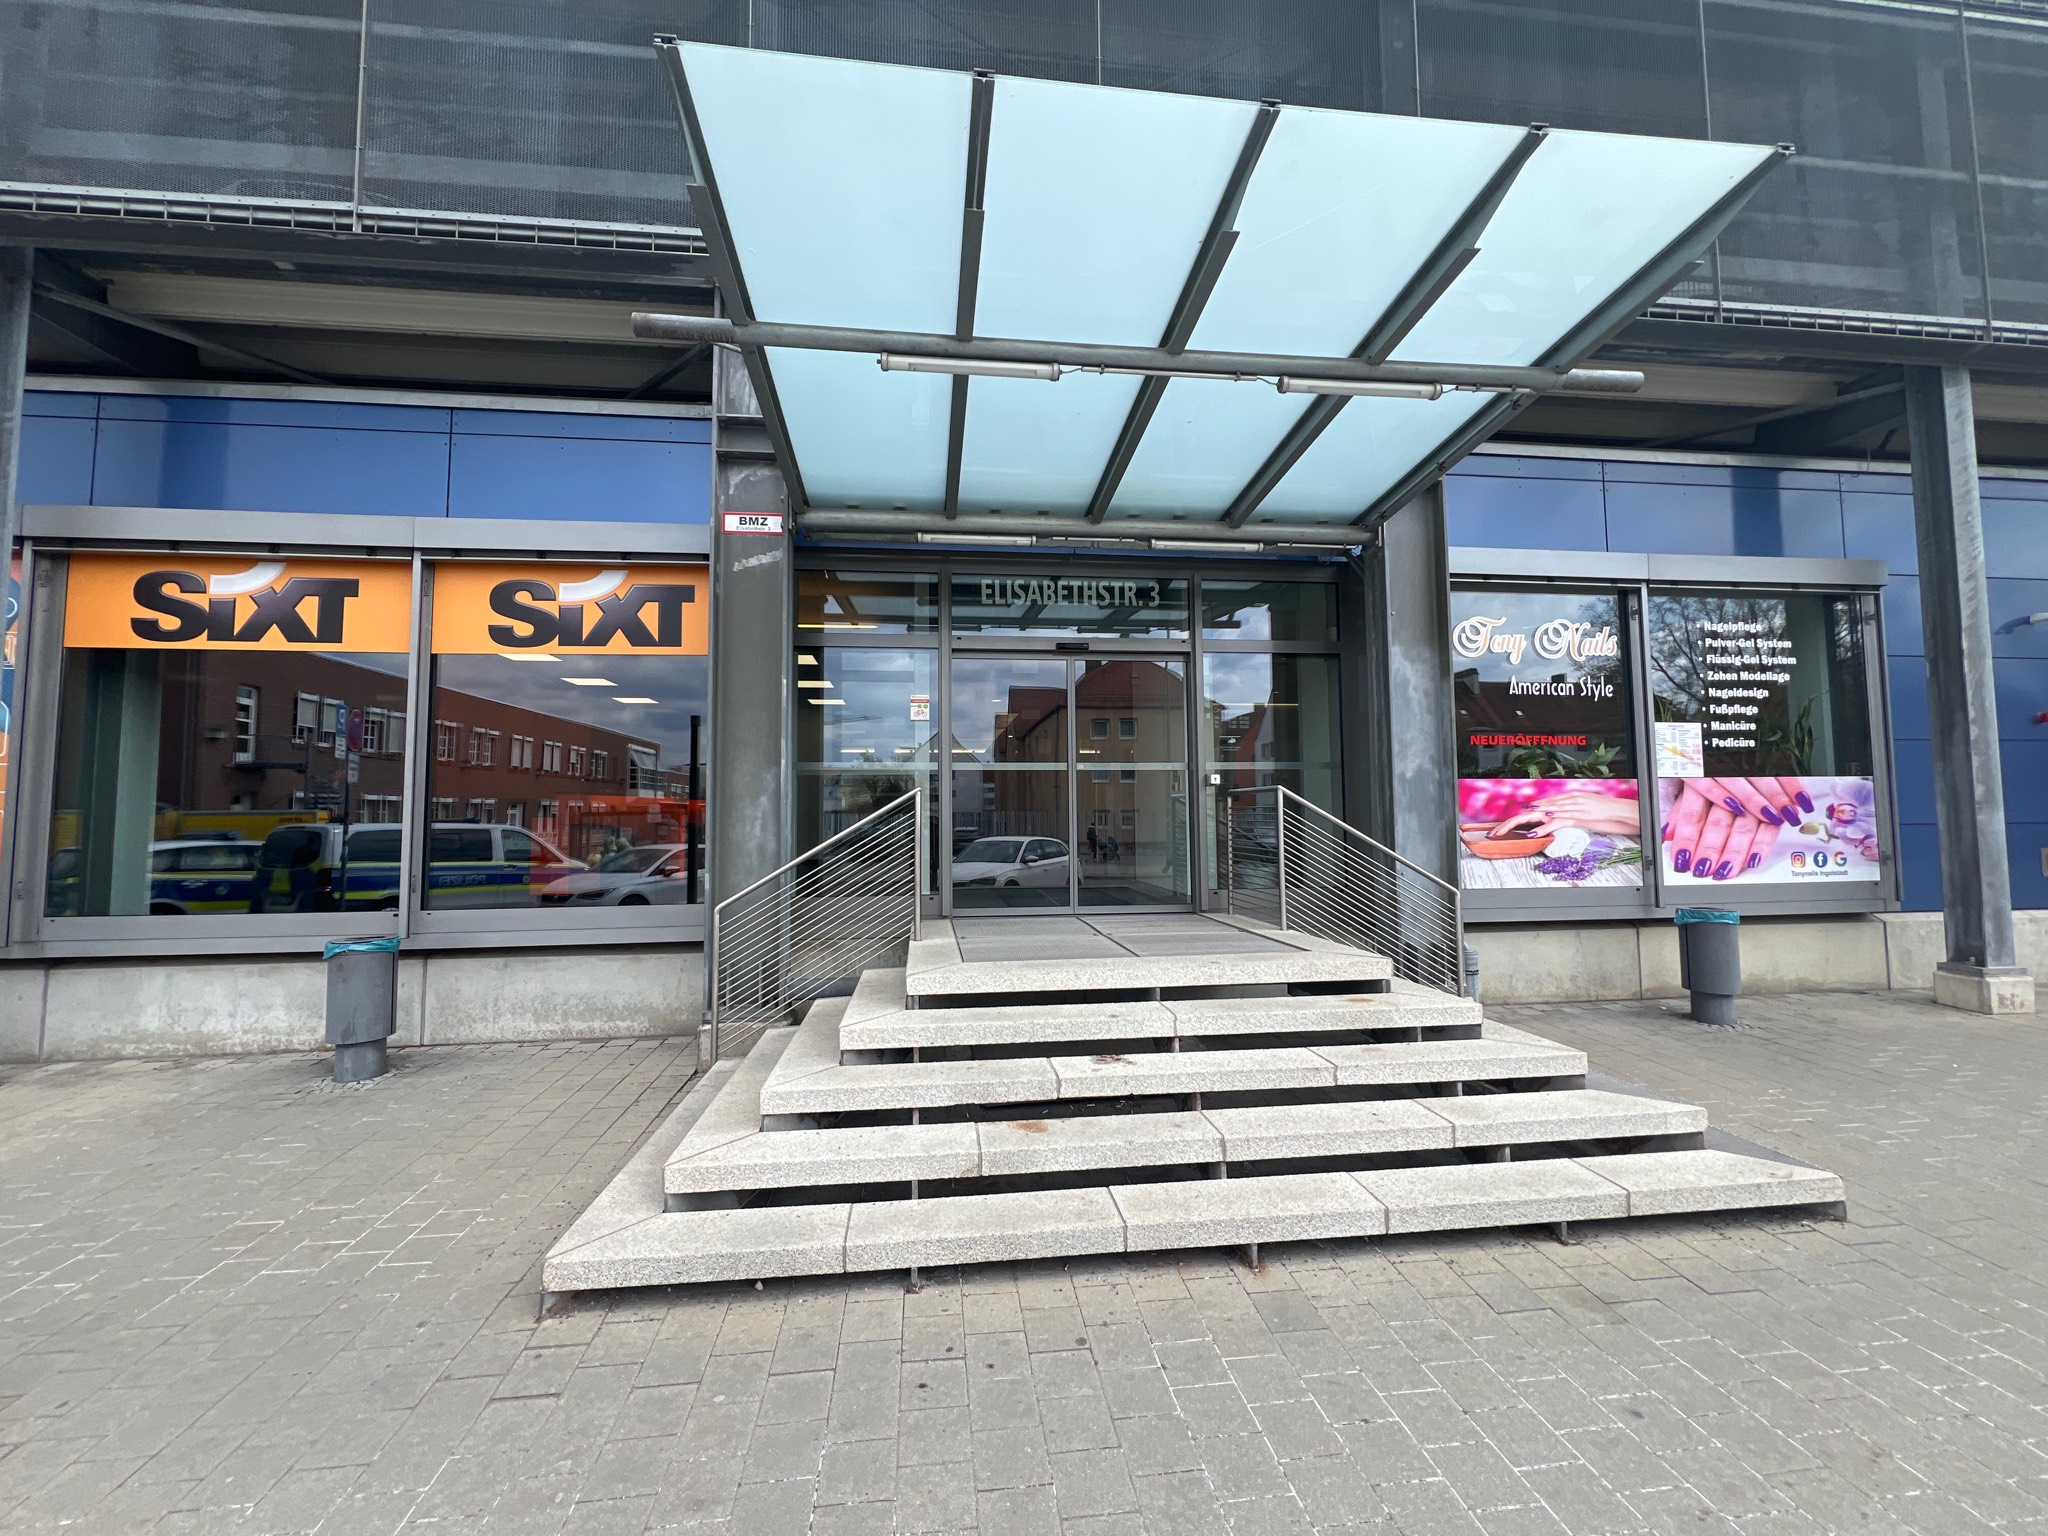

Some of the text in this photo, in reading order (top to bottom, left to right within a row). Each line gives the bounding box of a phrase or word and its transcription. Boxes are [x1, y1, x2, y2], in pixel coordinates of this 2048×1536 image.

[739, 516, 768, 526] BMZ
[981, 578, 1160, 608] ELISABETHSTR. 3
[1703, 621, 1762, 633] Nagelpflege
[1532, 618, 1618, 662] Nails
[1705, 638, 1792, 650] Pulver-Gel System
[1706, 653, 1797, 666] Flüssig-Gel System
[1707, 670, 1791, 683] Zehen Modellage
[1509, 674, 1614, 702] American Style
[1708, 687, 1769, 699] Nageldesign
[1709, 703, 1758, 715] Fußpflege
[1710, 720, 1757, 731] Manicüre
[1711, 737, 1756, 748] Pedicüre
